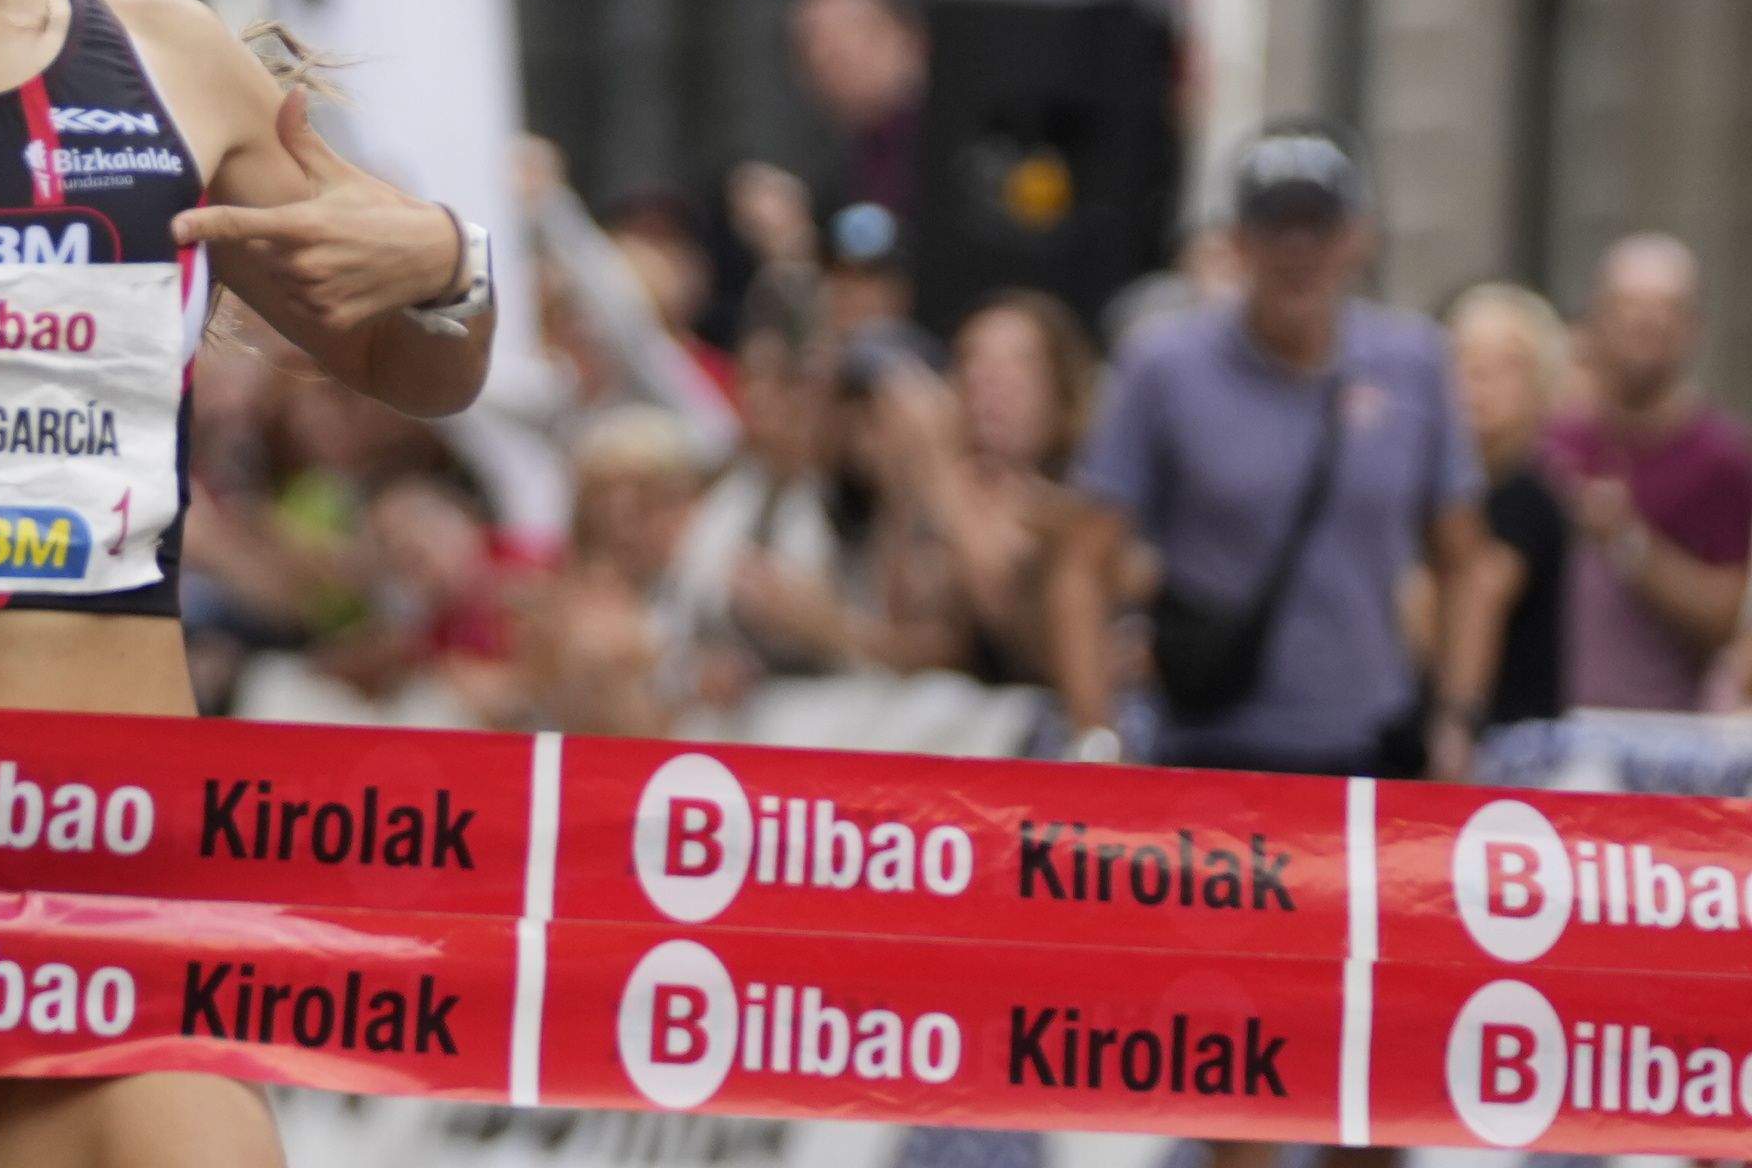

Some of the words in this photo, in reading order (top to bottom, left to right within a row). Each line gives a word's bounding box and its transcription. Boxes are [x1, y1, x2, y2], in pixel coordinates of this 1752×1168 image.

[52, 145, 184, 174] Bizkaialde
[106, 485, 133, 557] 1
[199, 778, 477, 870] Kirolak
[660, 794, 975, 897] Bilbao
[1017, 820, 1298, 913] Kirolak
[1482, 839, 1752, 932] Bilba
[180, 961, 460, 1056] Kirolak
[646, 982, 964, 1085] Bilbao
[1008, 1006, 1288, 1098] Kirolak
[1477, 1020, 1752, 1119] Bilba
